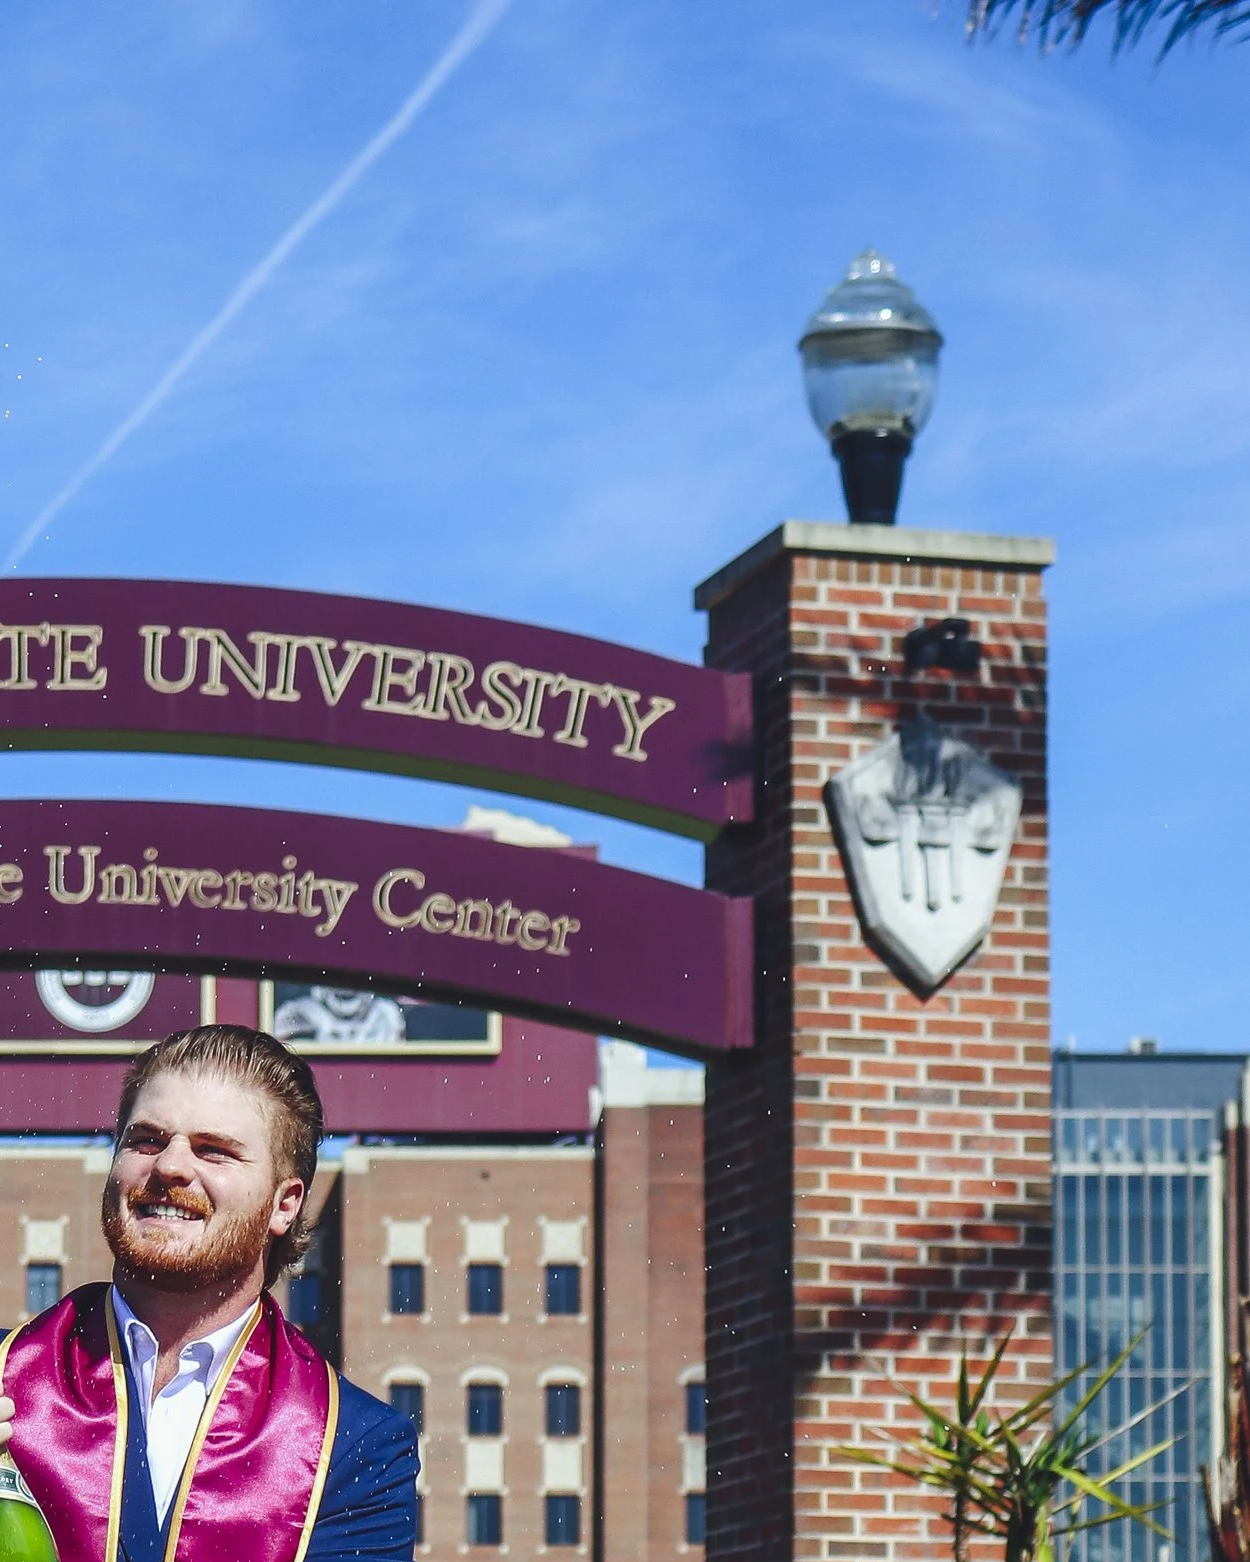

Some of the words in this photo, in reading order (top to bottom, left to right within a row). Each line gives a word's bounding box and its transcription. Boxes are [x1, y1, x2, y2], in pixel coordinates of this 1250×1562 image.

[139, 625, 675, 761] UNIVERSITY
[43, 845, 357, 936] University
[373, 868, 581, 956] Center
